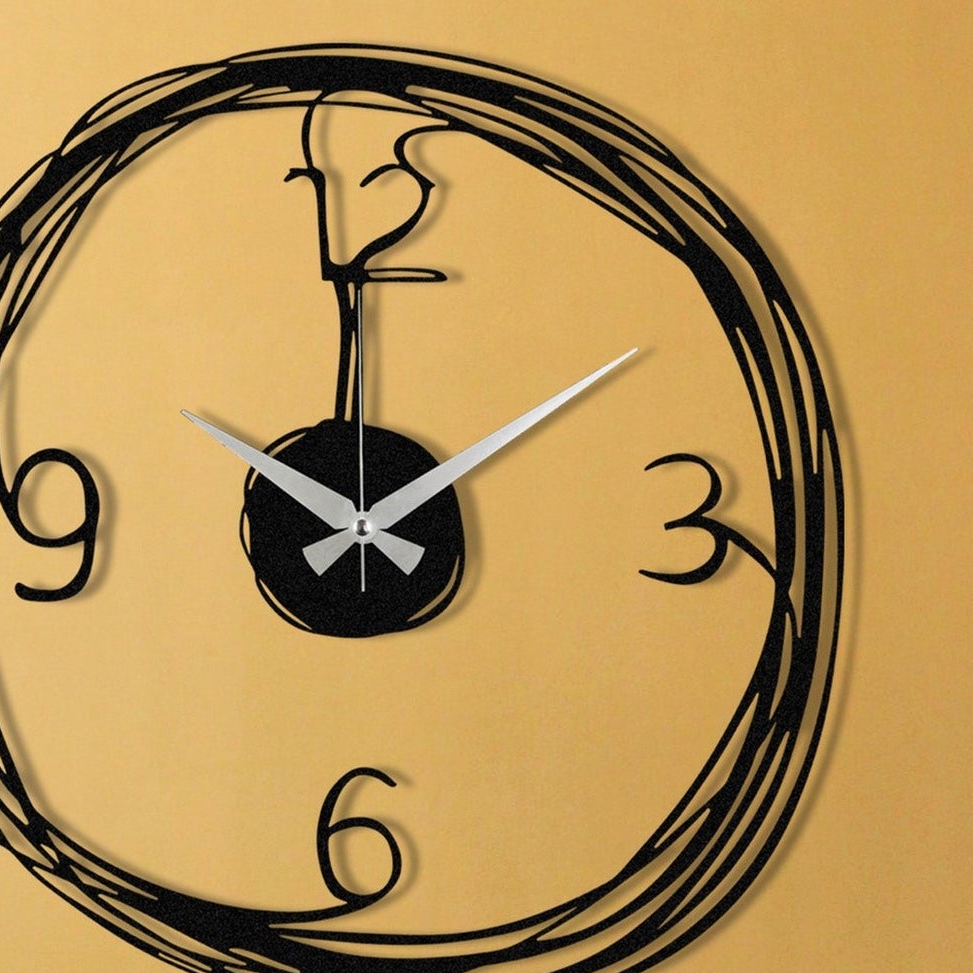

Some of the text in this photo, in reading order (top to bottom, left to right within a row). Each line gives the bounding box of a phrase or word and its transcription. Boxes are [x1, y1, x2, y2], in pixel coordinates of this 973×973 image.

[284, 125, 448, 282] 12
[1, 448, 100, 602] 9
[638, 453, 731, 585] 3
[316, 767, 402, 909] 6
